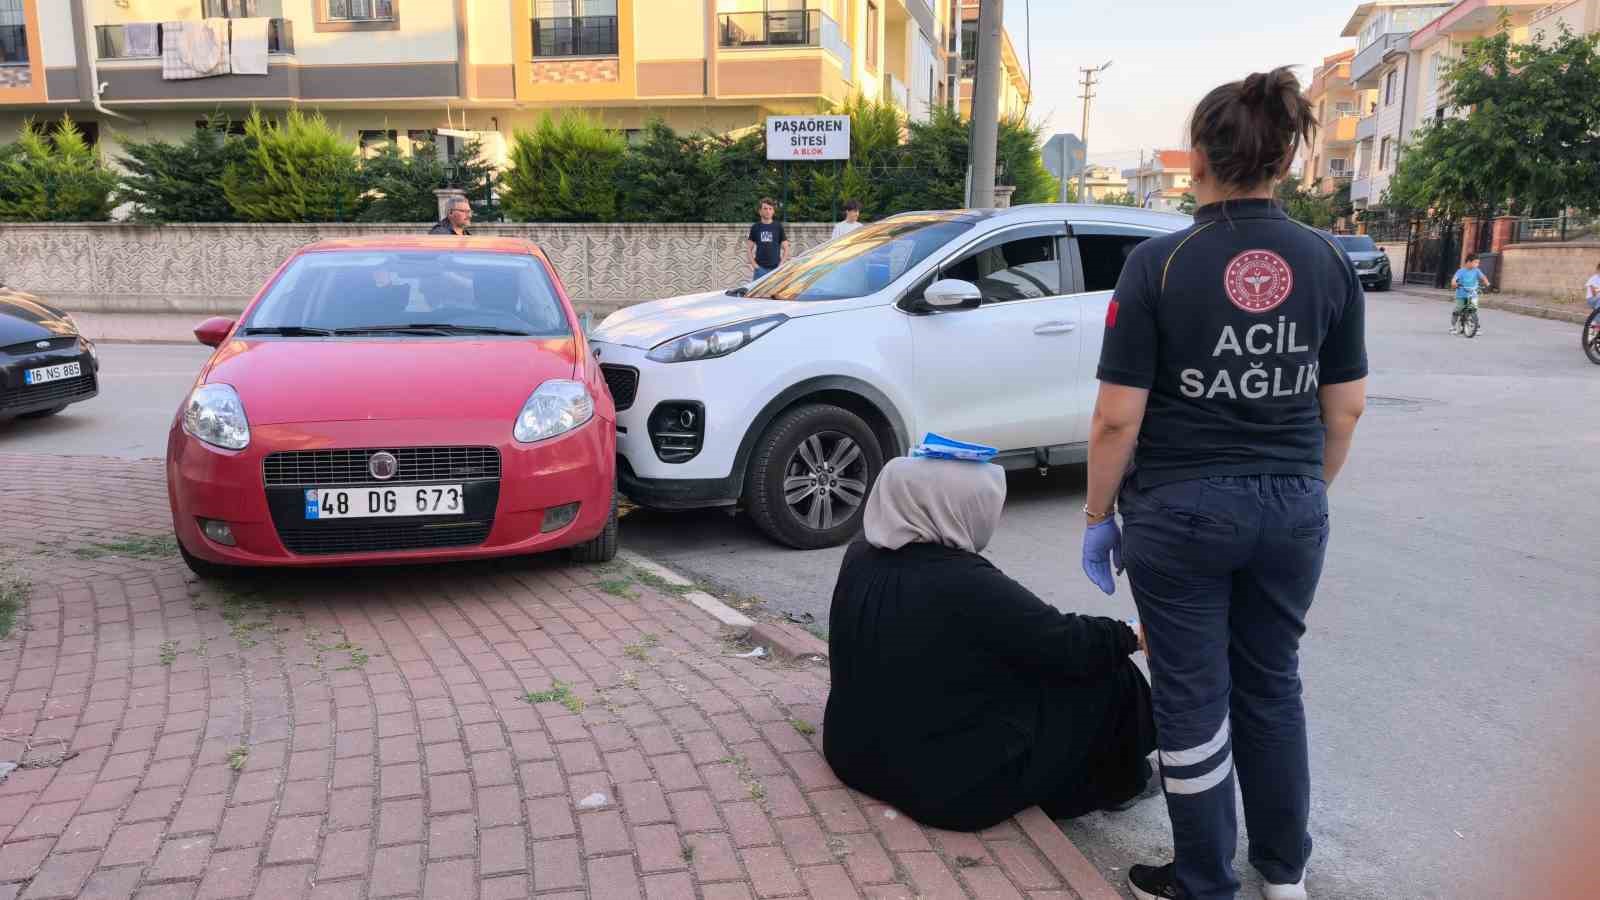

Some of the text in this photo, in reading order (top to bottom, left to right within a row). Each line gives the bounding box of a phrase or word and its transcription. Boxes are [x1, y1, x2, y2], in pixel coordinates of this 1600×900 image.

[774, 118, 842, 134] PAŞAÖREN
[791, 134, 826, 146] SİTESİ
[1212, 315, 1309, 357] ACİL
[32, 370, 42, 382] 16
[46, 367, 61, 379] NS
[1180, 360, 1320, 399] SAĞLIK
[321, 488, 460, 515] 48 DG 673
